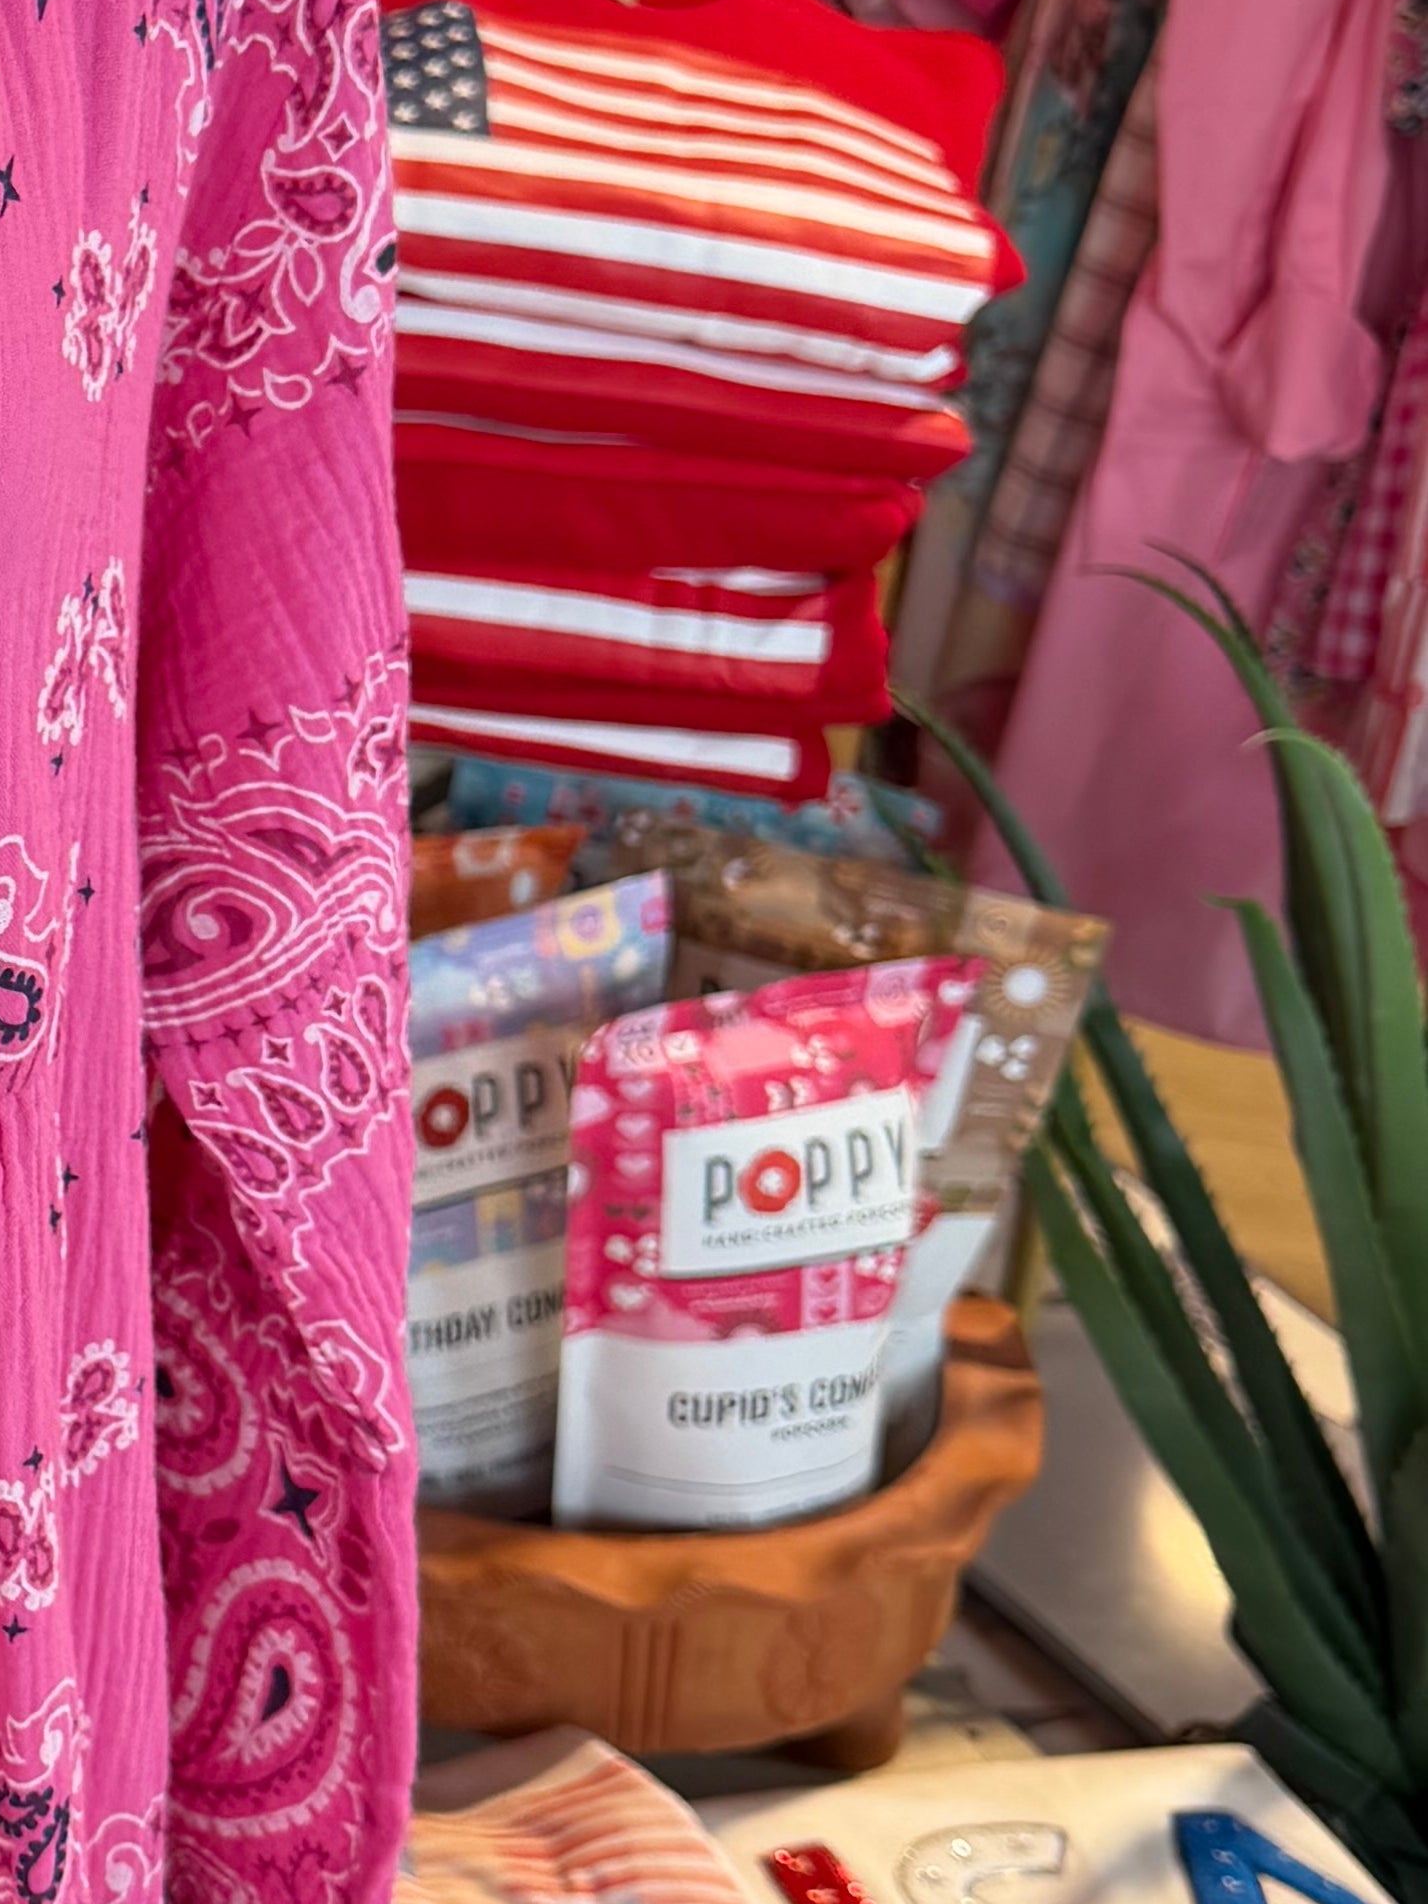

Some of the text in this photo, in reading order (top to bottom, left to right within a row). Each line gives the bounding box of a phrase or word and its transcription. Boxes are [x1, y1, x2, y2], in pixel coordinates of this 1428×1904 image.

[414, 1054, 576, 1150] OPPY
[702, 1118, 906, 1224] POPPY
[667, 1382, 800, 1429] CUPID'S
